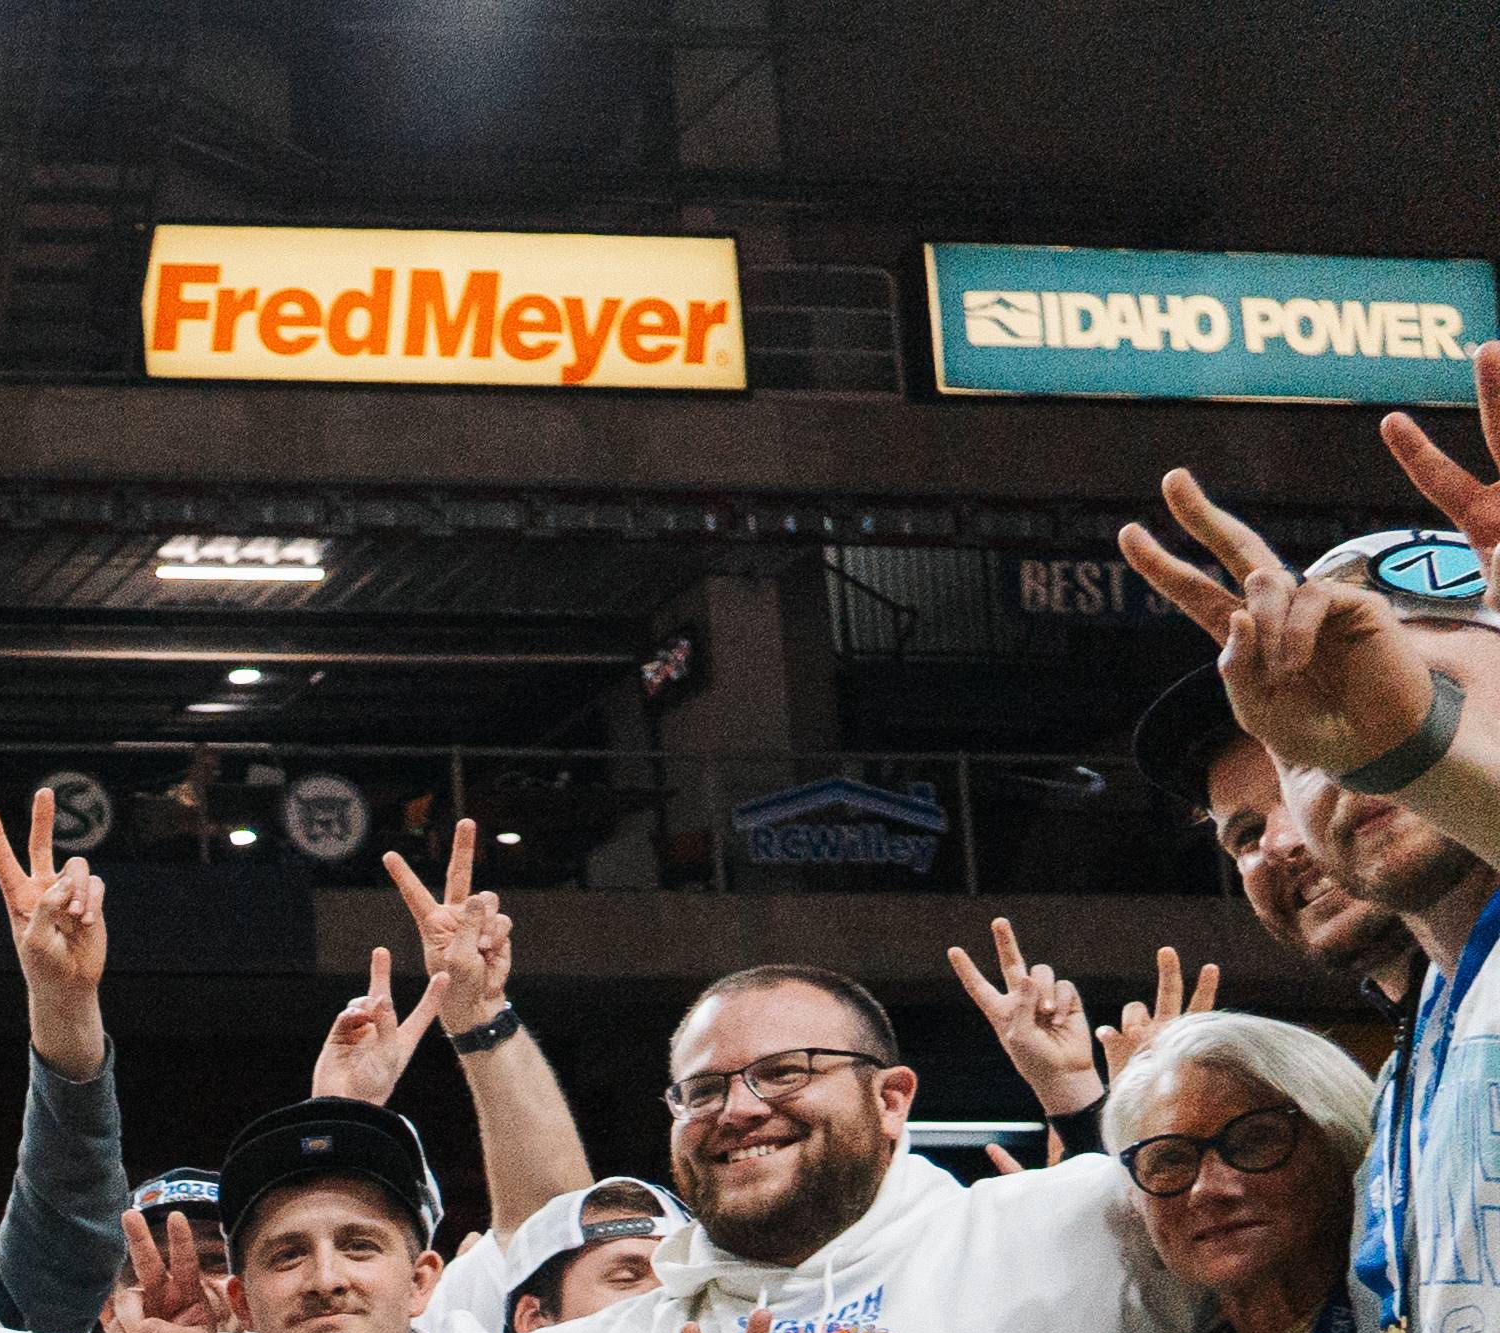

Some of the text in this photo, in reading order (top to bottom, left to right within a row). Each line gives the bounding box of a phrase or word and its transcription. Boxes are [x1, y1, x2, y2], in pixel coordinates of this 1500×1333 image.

[1042, 291, 1468, 361] IDAHO POWER
[1019, 559, 1126, 615] BEST
